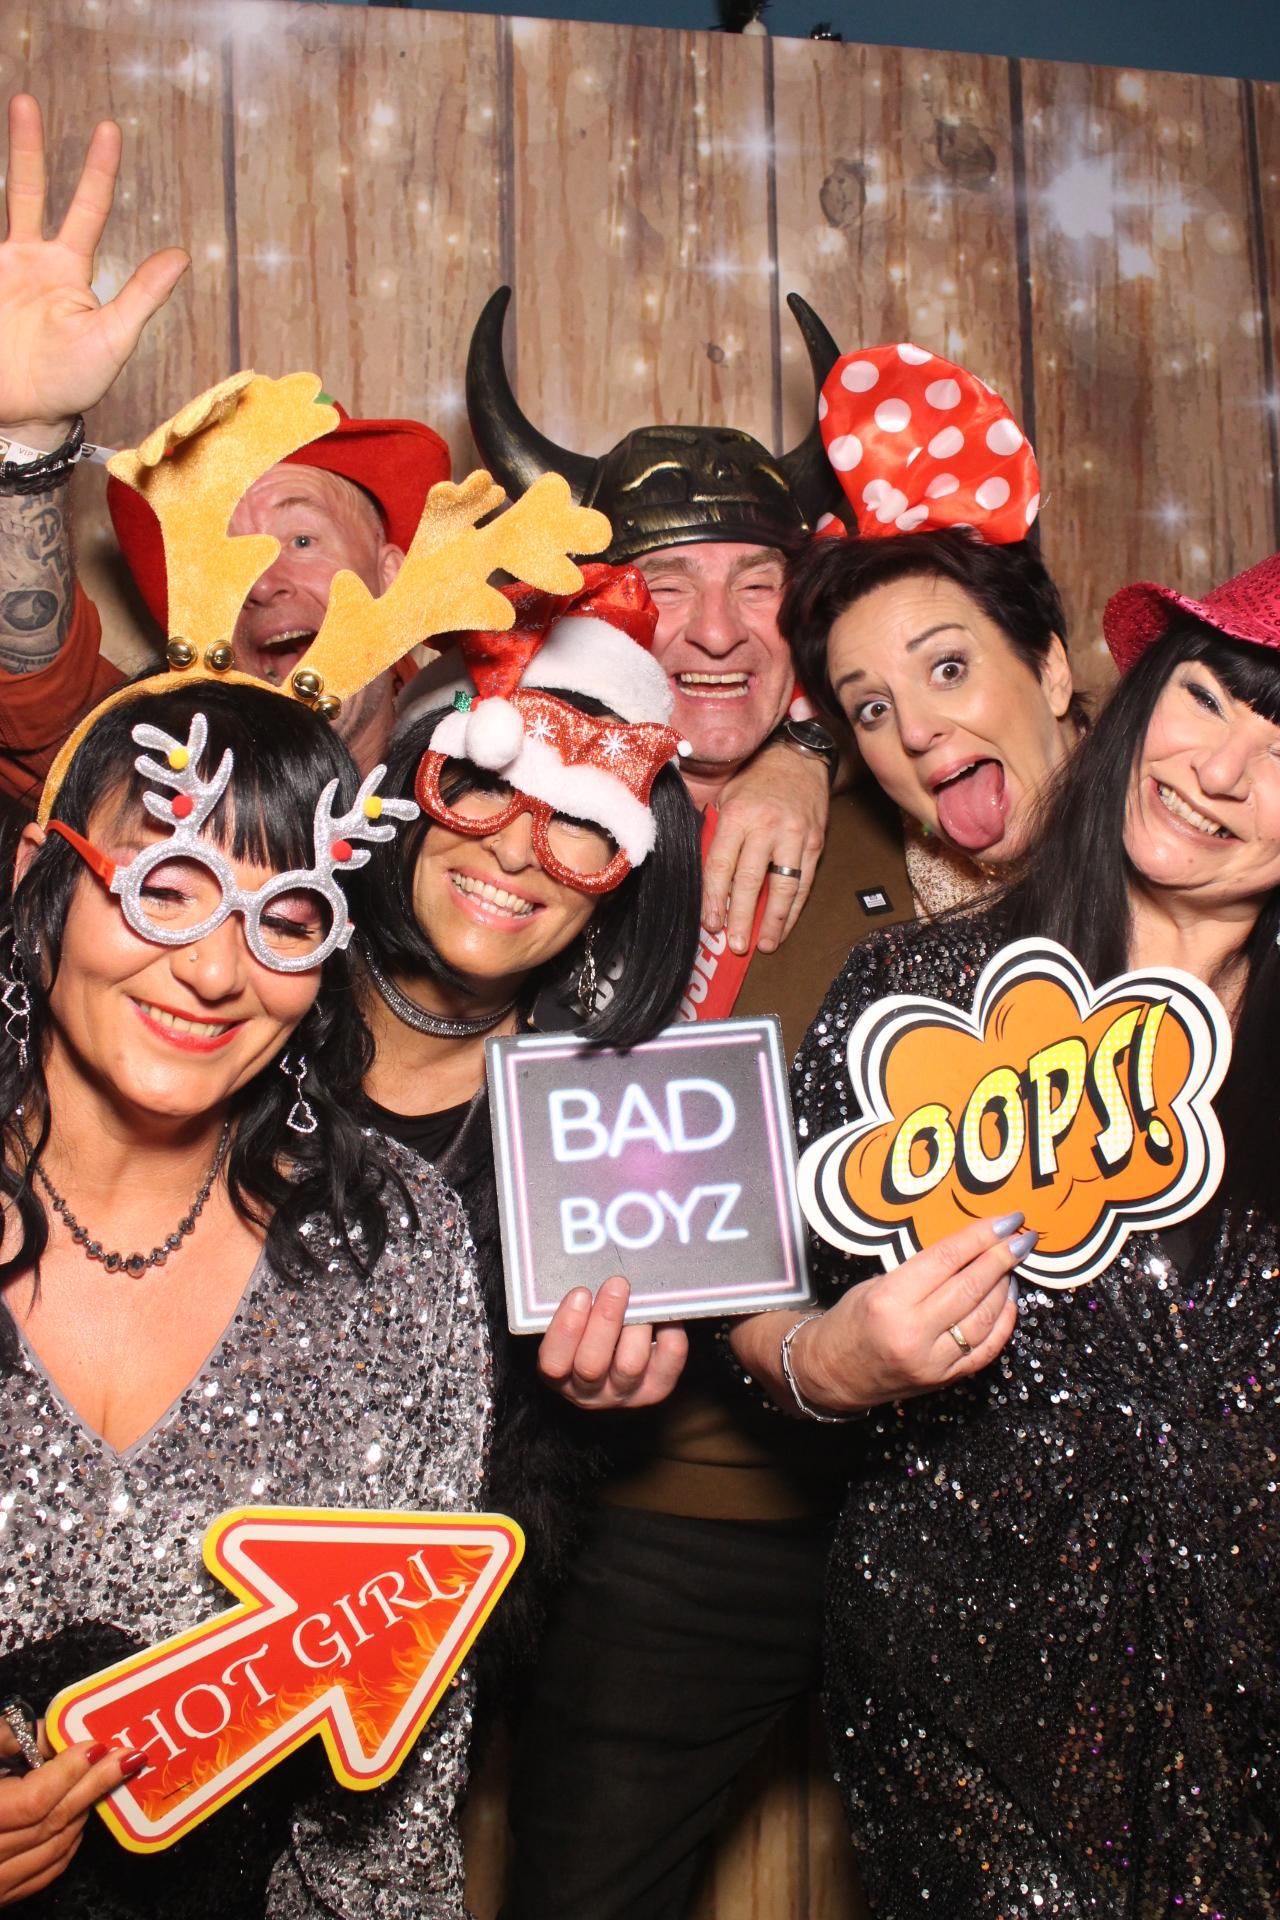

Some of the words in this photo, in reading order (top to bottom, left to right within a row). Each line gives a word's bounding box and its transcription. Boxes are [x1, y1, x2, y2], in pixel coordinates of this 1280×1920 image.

[548, 1078, 736, 1162] BAD
[881, 998, 1174, 1205] OOPS!
[560, 1183, 749, 1254] BOYZ
[109, 1643, 276, 1779] HOT
[292, 1549, 466, 1669] GIRL
